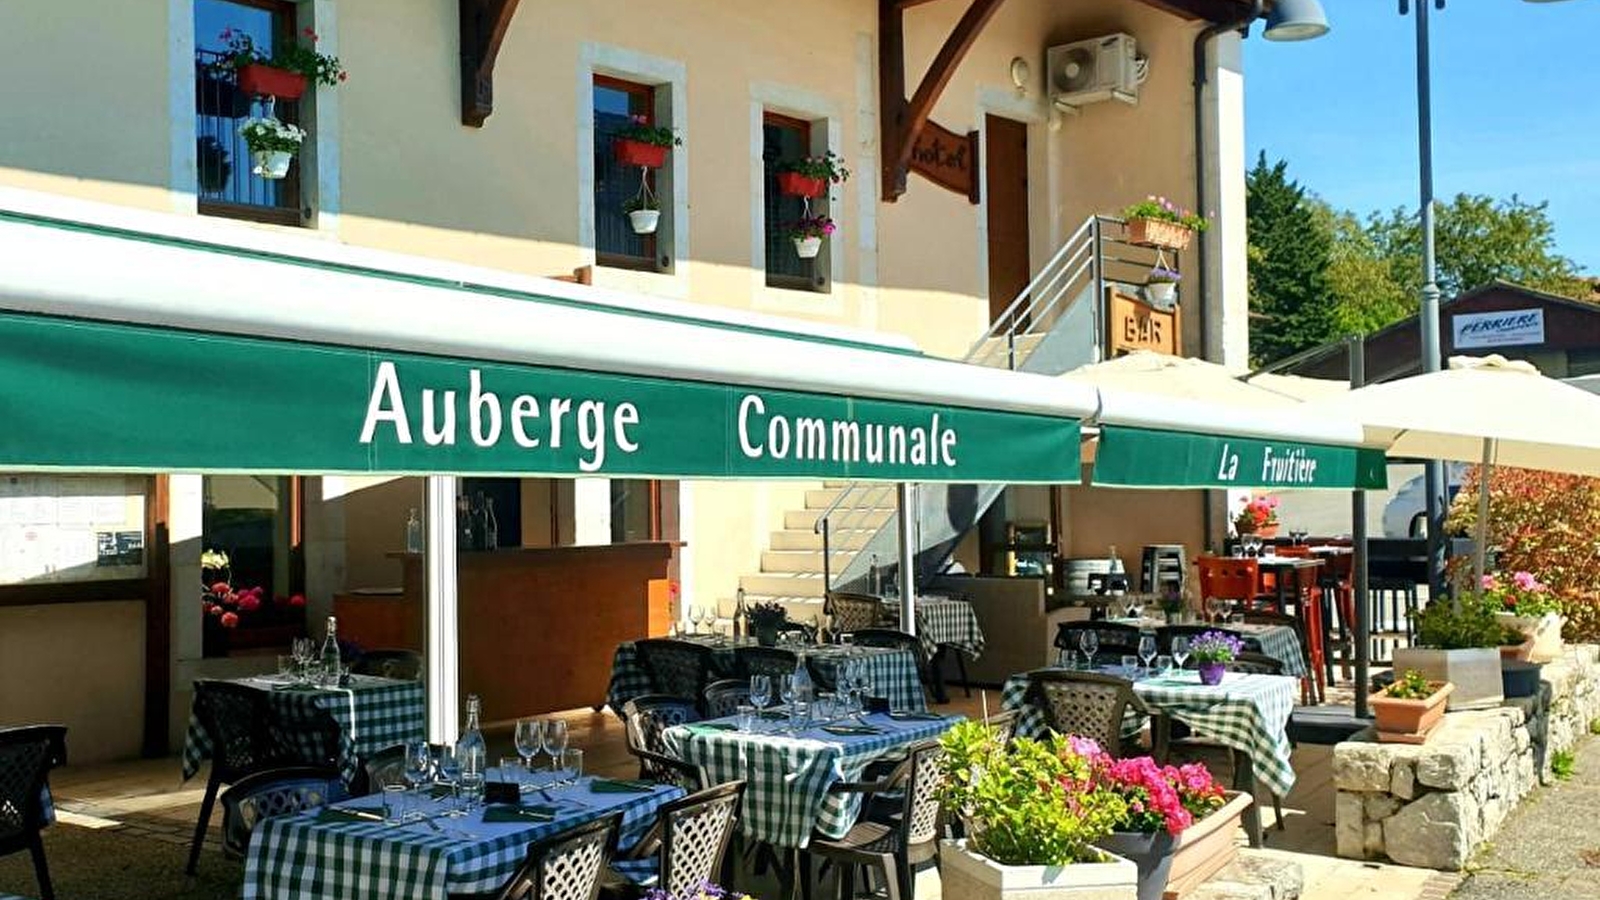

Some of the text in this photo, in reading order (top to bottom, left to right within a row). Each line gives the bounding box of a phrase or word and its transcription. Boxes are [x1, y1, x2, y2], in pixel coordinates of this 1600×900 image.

[1124, 315, 1161, 344] BAR
[359, 361, 957, 472] Auberge Communale
[1218, 444, 1317, 482] La Fruitière
